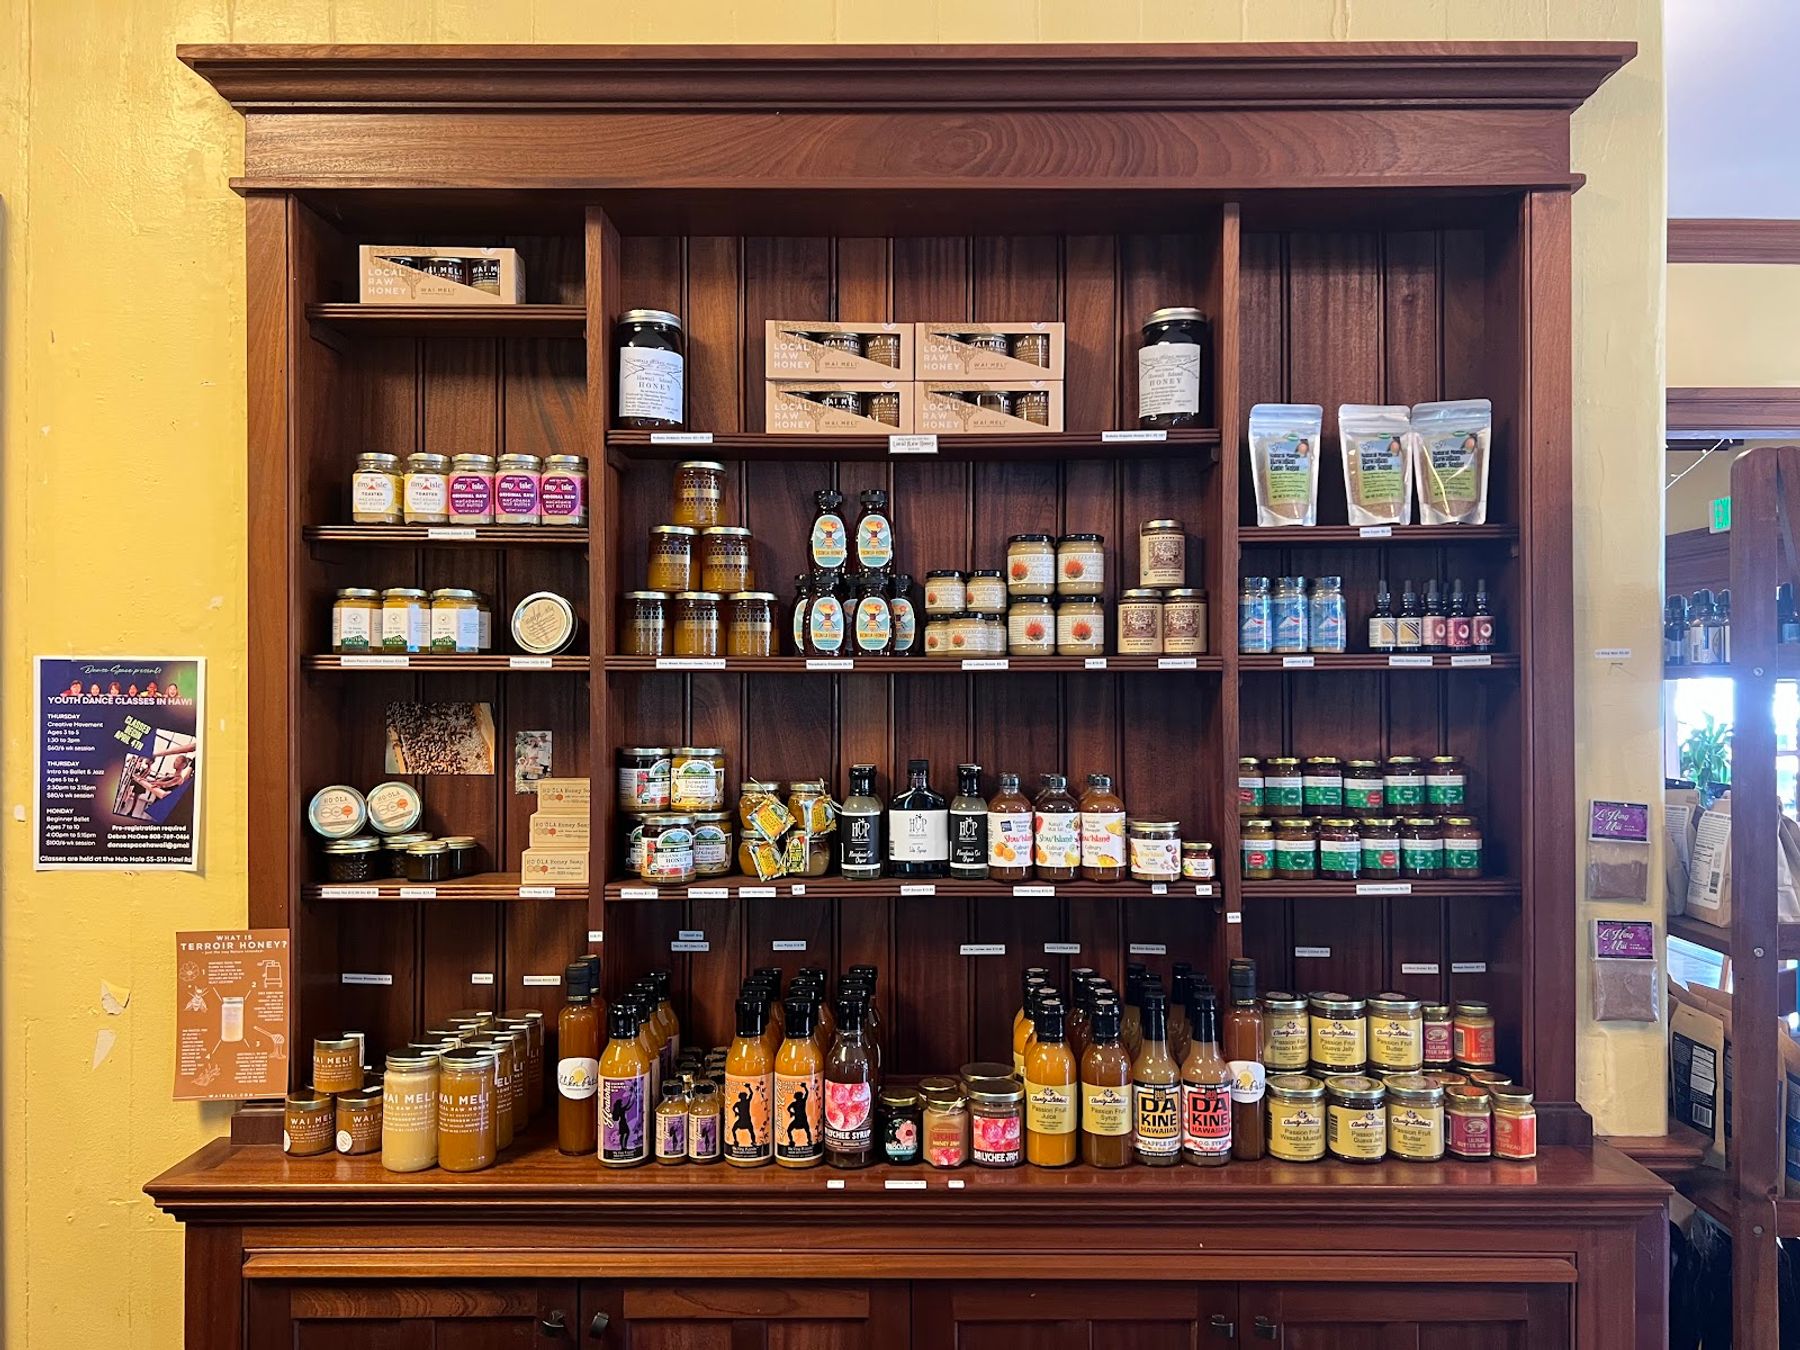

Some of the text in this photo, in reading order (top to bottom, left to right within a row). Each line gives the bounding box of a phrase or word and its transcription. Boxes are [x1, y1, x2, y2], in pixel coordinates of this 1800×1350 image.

[368, 269, 406, 277] LOCAL
[367, 278, 393, 286] RAW
[367, 287, 407, 295] HONEY
[774, 343, 810, 351] LOCAL
[923, 345, 960, 353] LOCAL
[774, 352, 798, 360] RAW
[923, 353, 949, 361] RAW
[774, 361, 811, 369] HONEY
[923, 362, 960, 371] HONEY
[638, 381, 672, 392] HONEY
[1149, 378, 1182, 386] HONEY
[774, 403, 810, 411] LOCAL
[922, 403, 960, 411] LOCAL
[774, 412, 799, 420] RAW
[922, 412, 948, 420] RAW
[774, 421, 811, 429] HONEY
[922, 421, 960, 430] HONEY
[47, 697, 193, 706] YOUTH DANCE CLASSES IN HAWI
[124, 715, 152, 735] CLASSES
[1594, 809, 1630, 822] Li Hing
[1599, 929, 1634, 941] Li Hing
[180, 940, 288, 951] TERROIR HONEY?
[1377, 1038, 1399, 1046] Passion
[327, 1055, 353, 1065] MELI
[404, 1090, 436, 1104] MELI
[458, 1092, 490, 1105] MELI
[1031, 1104, 1054, 1113] Passion
[1140, 1097, 1177, 1113] DA
[1192, 1097, 1228, 1113] DA
[1091, 1107, 1114, 1115] Passion
[290, 1111, 336, 1126] WAI MELI
[352, 1114, 375, 1124] WAI
[1100, 1114, 1118, 1122] Syrup
[1141, 1113, 1178, 1127] KINE
[1192, 1113, 1228, 1127] KINE
[1140, 1126, 1178, 1134] HAWAIIAN
[1191, 1126, 1229, 1134] HAWAIIAN
[1351, 1130, 1373, 1138] Passion
[1393, 1127, 1417, 1136] Passion
[851, 1130, 871, 1140] SYRUP
[1006, 1151, 1019, 1162] JAM
